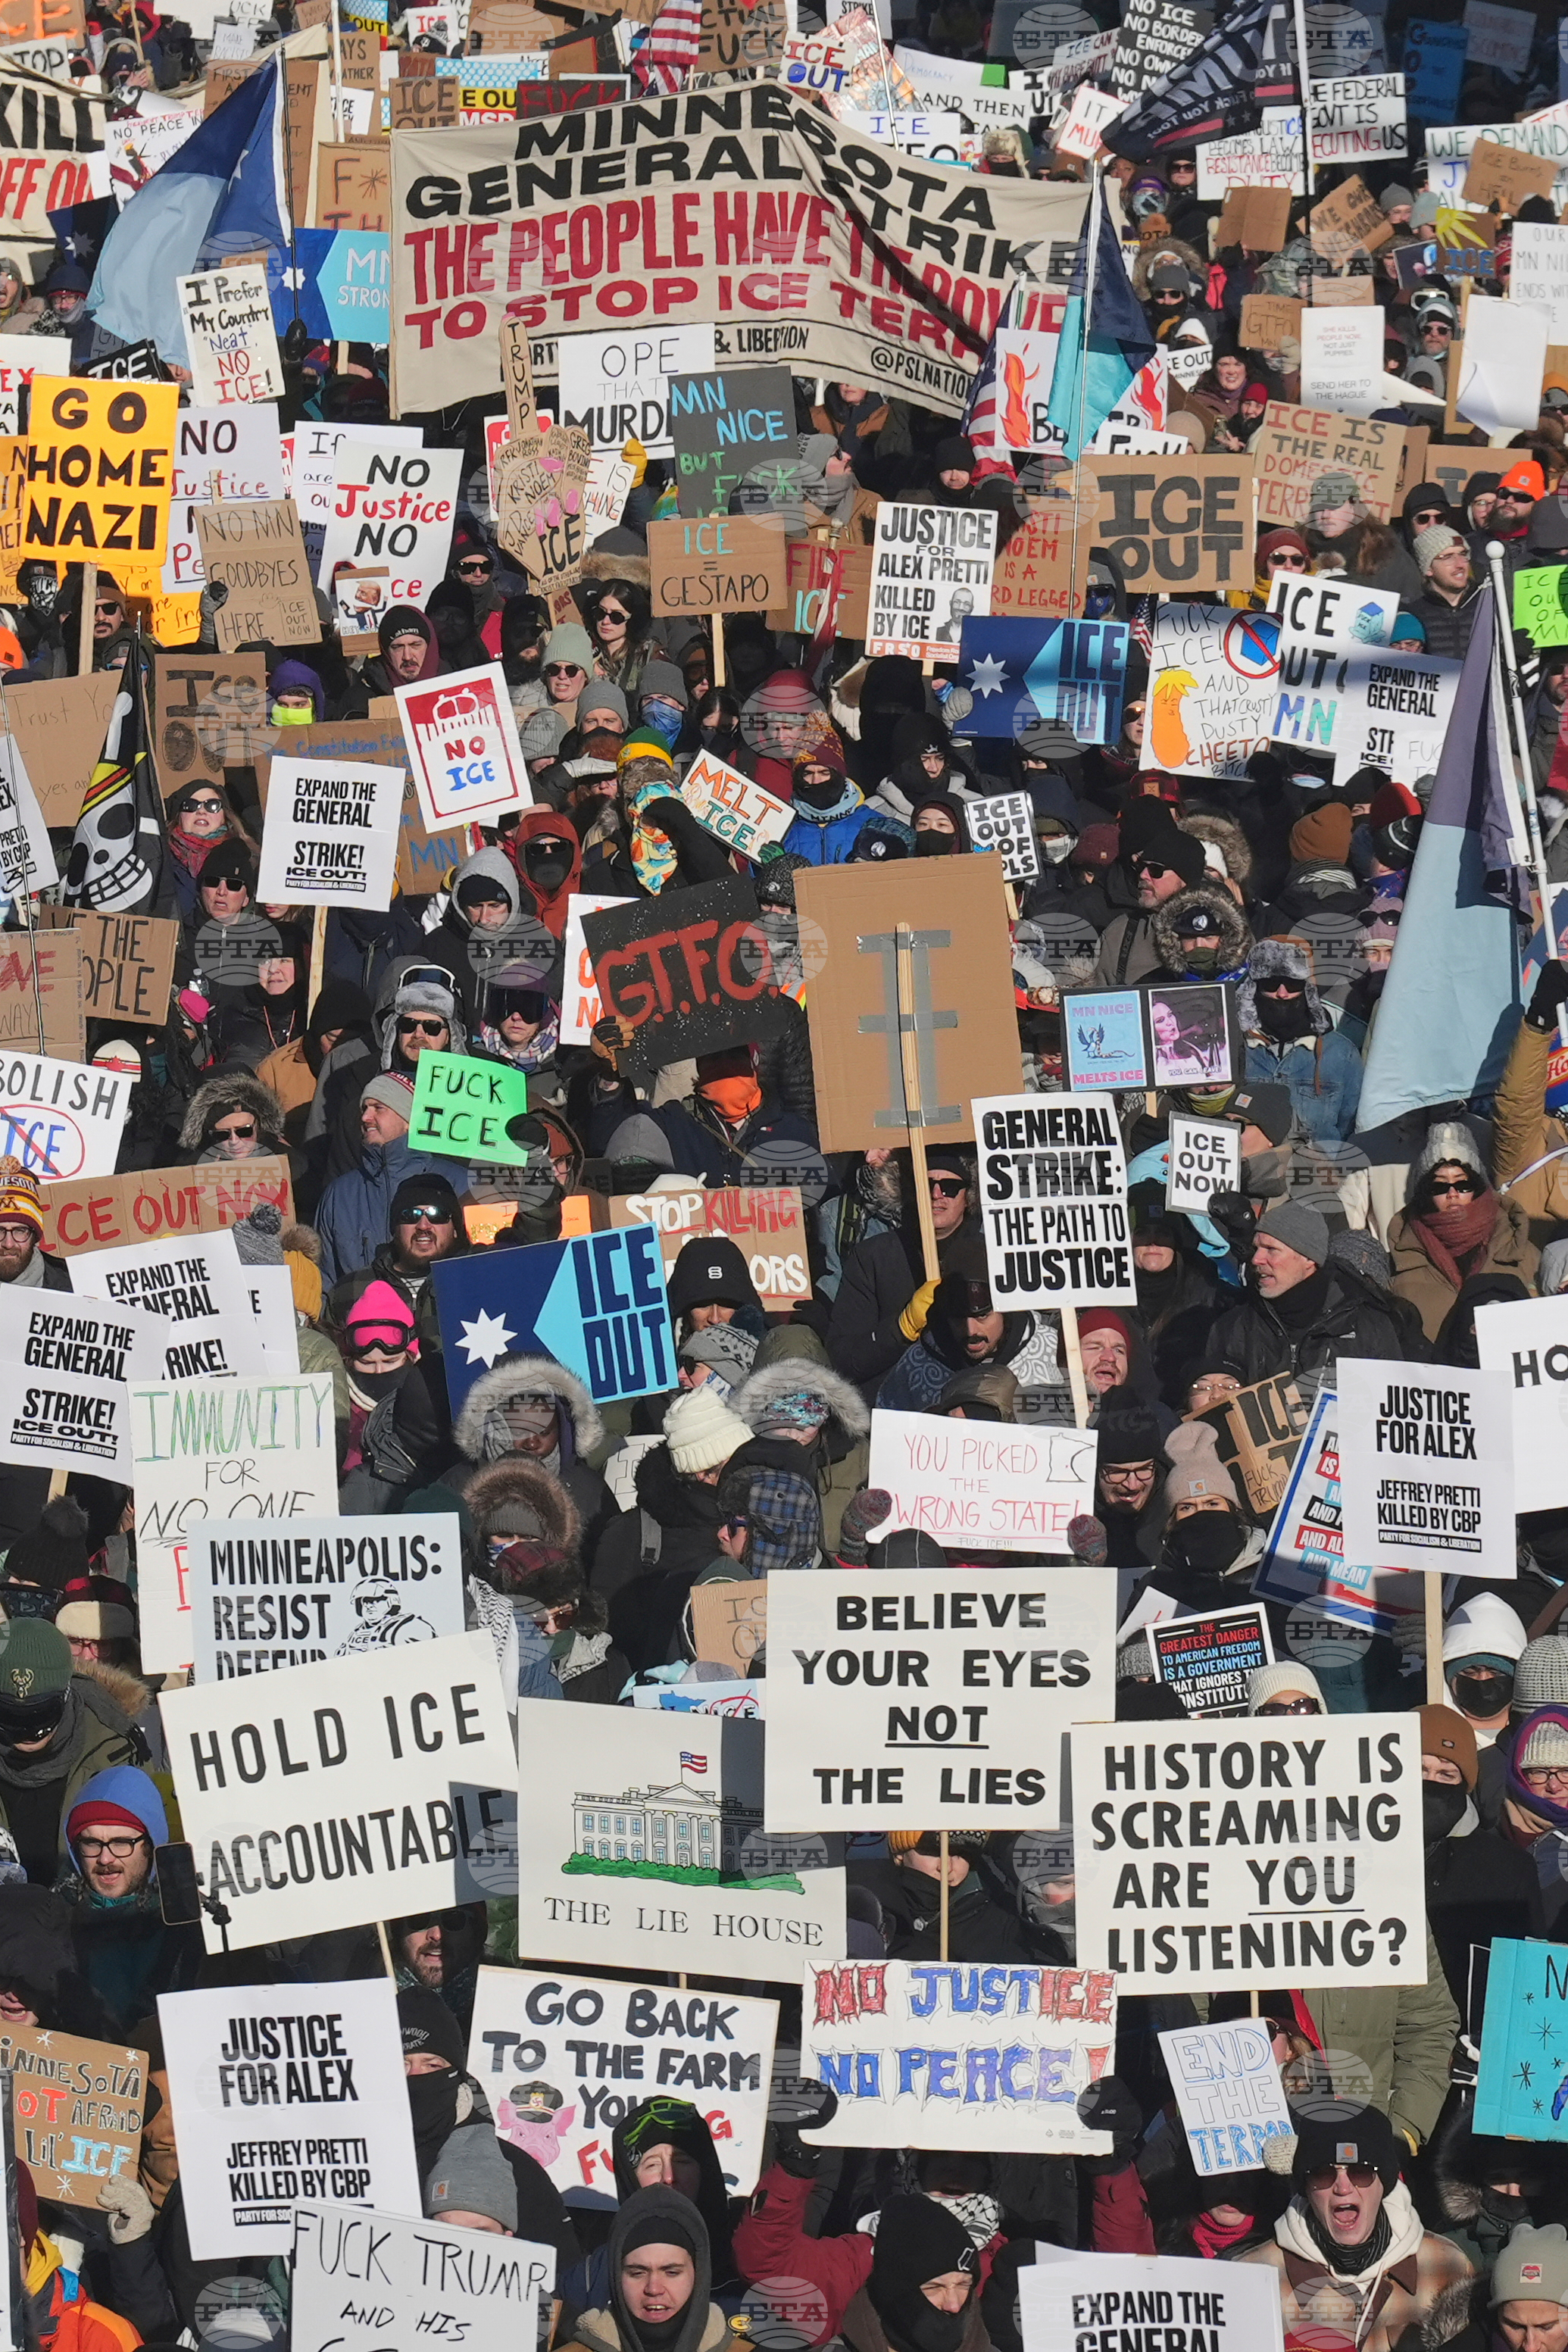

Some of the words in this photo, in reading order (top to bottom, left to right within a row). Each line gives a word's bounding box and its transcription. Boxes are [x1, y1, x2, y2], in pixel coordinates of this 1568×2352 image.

[1123, 13, 1149, 33] NO
[1160, 2, 1196, 27] ICE
[786, 40, 847, 69] ICE
[1115, 45, 1141, 66] NO
[395, 79, 456, 114] ICE
[923, 92, 963, 110] AND
[973, 98, 1026, 118] THEN
[1332, 77, 1405, 100] FEDERAL
[114, 127, 133, 139] NO
[141, 118, 183, 136] PEACE
[1354, 103, 1378, 124] IS
[1382, 123, 1407, 151] US
[1431, 130, 1468, 157] WE
[515, 84, 996, 230] MINNESOTA
[406, 135, 803, 219] GENERAL
[404, 223, 498, 305] THE
[507, 192, 703, 291] PEOPLE
[186, 279, 211, 308] I
[405, 301, 487, 349] TO
[718, 272, 810, 311] ICE
[1246, 312, 1295, 336] GTFO
[672, 376, 726, 416] MN
[1311, 381, 1335, 390] SEND
[1338, 380, 1357, 389] HER
[1359, 379, 1371, 388] TO
[1315, 391, 1332, 400] THE
[1335, 389, 1368, 401] HAGUE
[181, 419, 237, 455] NO
[717, 409, 789, 445] NICE
[1266, 404, 1332, 437] ICE
[1340, 417, 1386, 445] IS
[570, 432, 591, 456] GREG
[1272, 434, 1327, 460] THE
[1332, 443, 1385, 471] REAL
[27, 445, 169, 487] HOME
[367, 454, 430, 487] NO
[679, 451, 726, 475] BUT
[507, 461, 540, 504] KRISTI
[524, 472, 556, 505] NOEM
[25, 496, 158, 550] NAZI
[1099, 473, 1244, 538] ICE
[354, 523, 417, 558] NO
[539, 513, 581, 576] ICE
[684, 523, 732, 555] ICE
[881, 506, 993, 549] JUSTICE
[877, 552, 930, 580] ALEX
[932, 557, 989, 585] PRETTI
[916, 545, 954, 557] FOR
[661, 573, 770, 607] GESTAPO
[874, 584, 935, 612] KILLED
[873, 613, 897, 636] BY
[901, 614, 930, 640] ICE
[1276, 582, 1341, 638] ICE
[1204, 674, 1250, 695] AND
[1369, 663, 1415, 685] EXPAND
[1273, 692, 1338, 745] MN
[1367, 684, 1437, 717] GENERAL
[444, 735, 486, 761] NO
[295, 777, 349, 800] EXPAND
[351, 782, 377, 802] THE
[445, 761, 495, 792] ICE
[688, 757, 783, 826] MELT
[292, 798, 373, 828] GENERAL
[695, 799, 757, 851] ICE
[973, 796, 1023, 822] ICE
[976, 816, 1027, 841] OUT
[997, 836, 1032, 856] OF
[293, 840, 365, 869] STRIKE!
[410, 836, 459, 873] MN
[96, 915, 149, 963] THE
[1072, 1004, 1096, 1017] MN
[1098, 1002, 1135, 1017] NICE
[429, 1064, 506, 1105] FUCK
[1073, 1070, 1118, 1085] MELTS
[1120, 1069, 1144, 1082] ICE
[417, 1106, 500, 1148] ICE
[982, 1107, 1118, 1151] GENERAL
[1184, 1131, 1226, 1154] ICE
[987, 1151, 1123, 1201] STRIKE:
[1179, 1152, 1232, 1176] OUT
[133, 1179, 206, 1235] OUT
[704, 1187, 801, 1235] KILLING
[988, 1207, 1035, 1247] THE
[1041, 1204, 1098, 1245] PATH
[1102, 1203, 1127, 1242] TO
[105, 1263, 176, 1298] EXPAND
[176, 1257, 211, 1282] THE
[571, 1226, 664, 1319] ICE
[995, 1247, 1132, 1294] JUSTICE
[28, 1311, 102, 1343] EXPAND
[102, 1322, 136, 1351] THE
[24, 1335, 128, 1382] GENERAL
[22, 1388, 117, 1430] STRIKE!
[1379, 1385, 1471, 1425] JUSTICE
[13, 1420, 53, 1434] ICE
[1376, 1419, 1420, 1457] FOR
[1424, 1424, 1478, 1460] ALEX
[904, 1433, 948, 1472] YOU
[962, 1438, 1039, 1475] PICKED
[205, 1457, 261, 1492] FOR
[949, 1477, 990, 1494] THE
[895, 1493, 980, 1530] WRONG
[1376, 1479, 1433, 1504] JEFFREY
[1435, 1483, 1481, 1508] PRETTI
[1307, 1501, 1336, 1523] AND
[1377, 1503, 1427, 1529] KILLED
[1429, 1507, 1448, 1531] BY
[1451, 1510, 1481, 1533] CBP
[1299, 1529, 1326, 1549] AND
[210, 1534, 442, 1586] MINNEAPOLIS:
[1330, 1560, 1367, 1585] MEAN
[213, 1593, 332, 1641] RESIST
[836, 1591, 1046, 1631] BELIEVE
[1199, 1622, 1216, 1633] THE
[351, 1635, 369, 1645] ICE
[1160, 1633, 1213, 1654] GREATEST
[1216, 1626, 1259, 1645] DANGER
[1161, 1656, 1173, 1666] TO
[1175, 1648, 1219, 1663] AMERICAN
[1220, 1640, 1261, 1657] FREEDOM
[792, 1648, 930, 1688] YOUR
[962, 1648, 1091, 1688] EYES
[1164, 1668, 1176, 1682] IS
[1177, 1667, 1186, 1679] A
[1187, 1652, 1263, 1677] GOVERNMENT
[1196, 1670, 1242, 1690] IGNORES
[189, 1707, 347, 1791] HOLD
[383, 1683, 486, 1760] ICE
[888, 1704, 988, 1742] NOT
[1104, 1738, 1326, 1791] HISTORY
[1358, 1732, 1404, 1784] IS
[813, 1766, 904, 1804] THE
[939, 1767, 1046, 1806] LIES
[1091, 1792, 1401, 1851] SCREAMING
[1112, 1862, 1210, 1909] ARE
[1247, 1855, 1356, 1907] YOU
[544, 1897, 611, 1926] THE
[636, 1907, 689, 1934] LIE
[712, 1913, 823, 1948] HOUSE
[1107, 1917, 1407, 1975] LISTENING?
[526, 1981, 604, 2026] GO
[626, 1987, 740, 2041] BACK
[812, 1962, 890, 2028] NO
[906, 1962, 1118, 2027] JUSTICE
[220, 2014, 348, 2063] JUSTICE
[1172, 2028, 1271, 2083] END
[483, 2031, 547, 2073] TO
[565, 2040, 644, 2080] THE
[656, 2047, 761, 2092] FARM
[813, 2047, 885, 2104] NO
[218, 2061, 281, 2108] FOR
[286, 2058, 360, 2104] ALEX
[1185, 2075, 1280, 2125] THE
[226, 2140, 301, 2169] JEFFREY
[306, 2138, 368, 2166] PRETTI
[228, 2172, 299, 2203] KILLED
[304, 2170, 329, 2200] BY
[331, 2169, 371, 2199] CBP
[293, 2209, 392, 2287] FUCK
[413, 2233, 548, 2304] TRUMP
[339, 2300, 395, 2330] AND
[415, 2310, 473, 2344] HIS
[1071, 2291, 1173, 2329] EXPAND
[1177, 2291, 1226, 2327] THE
